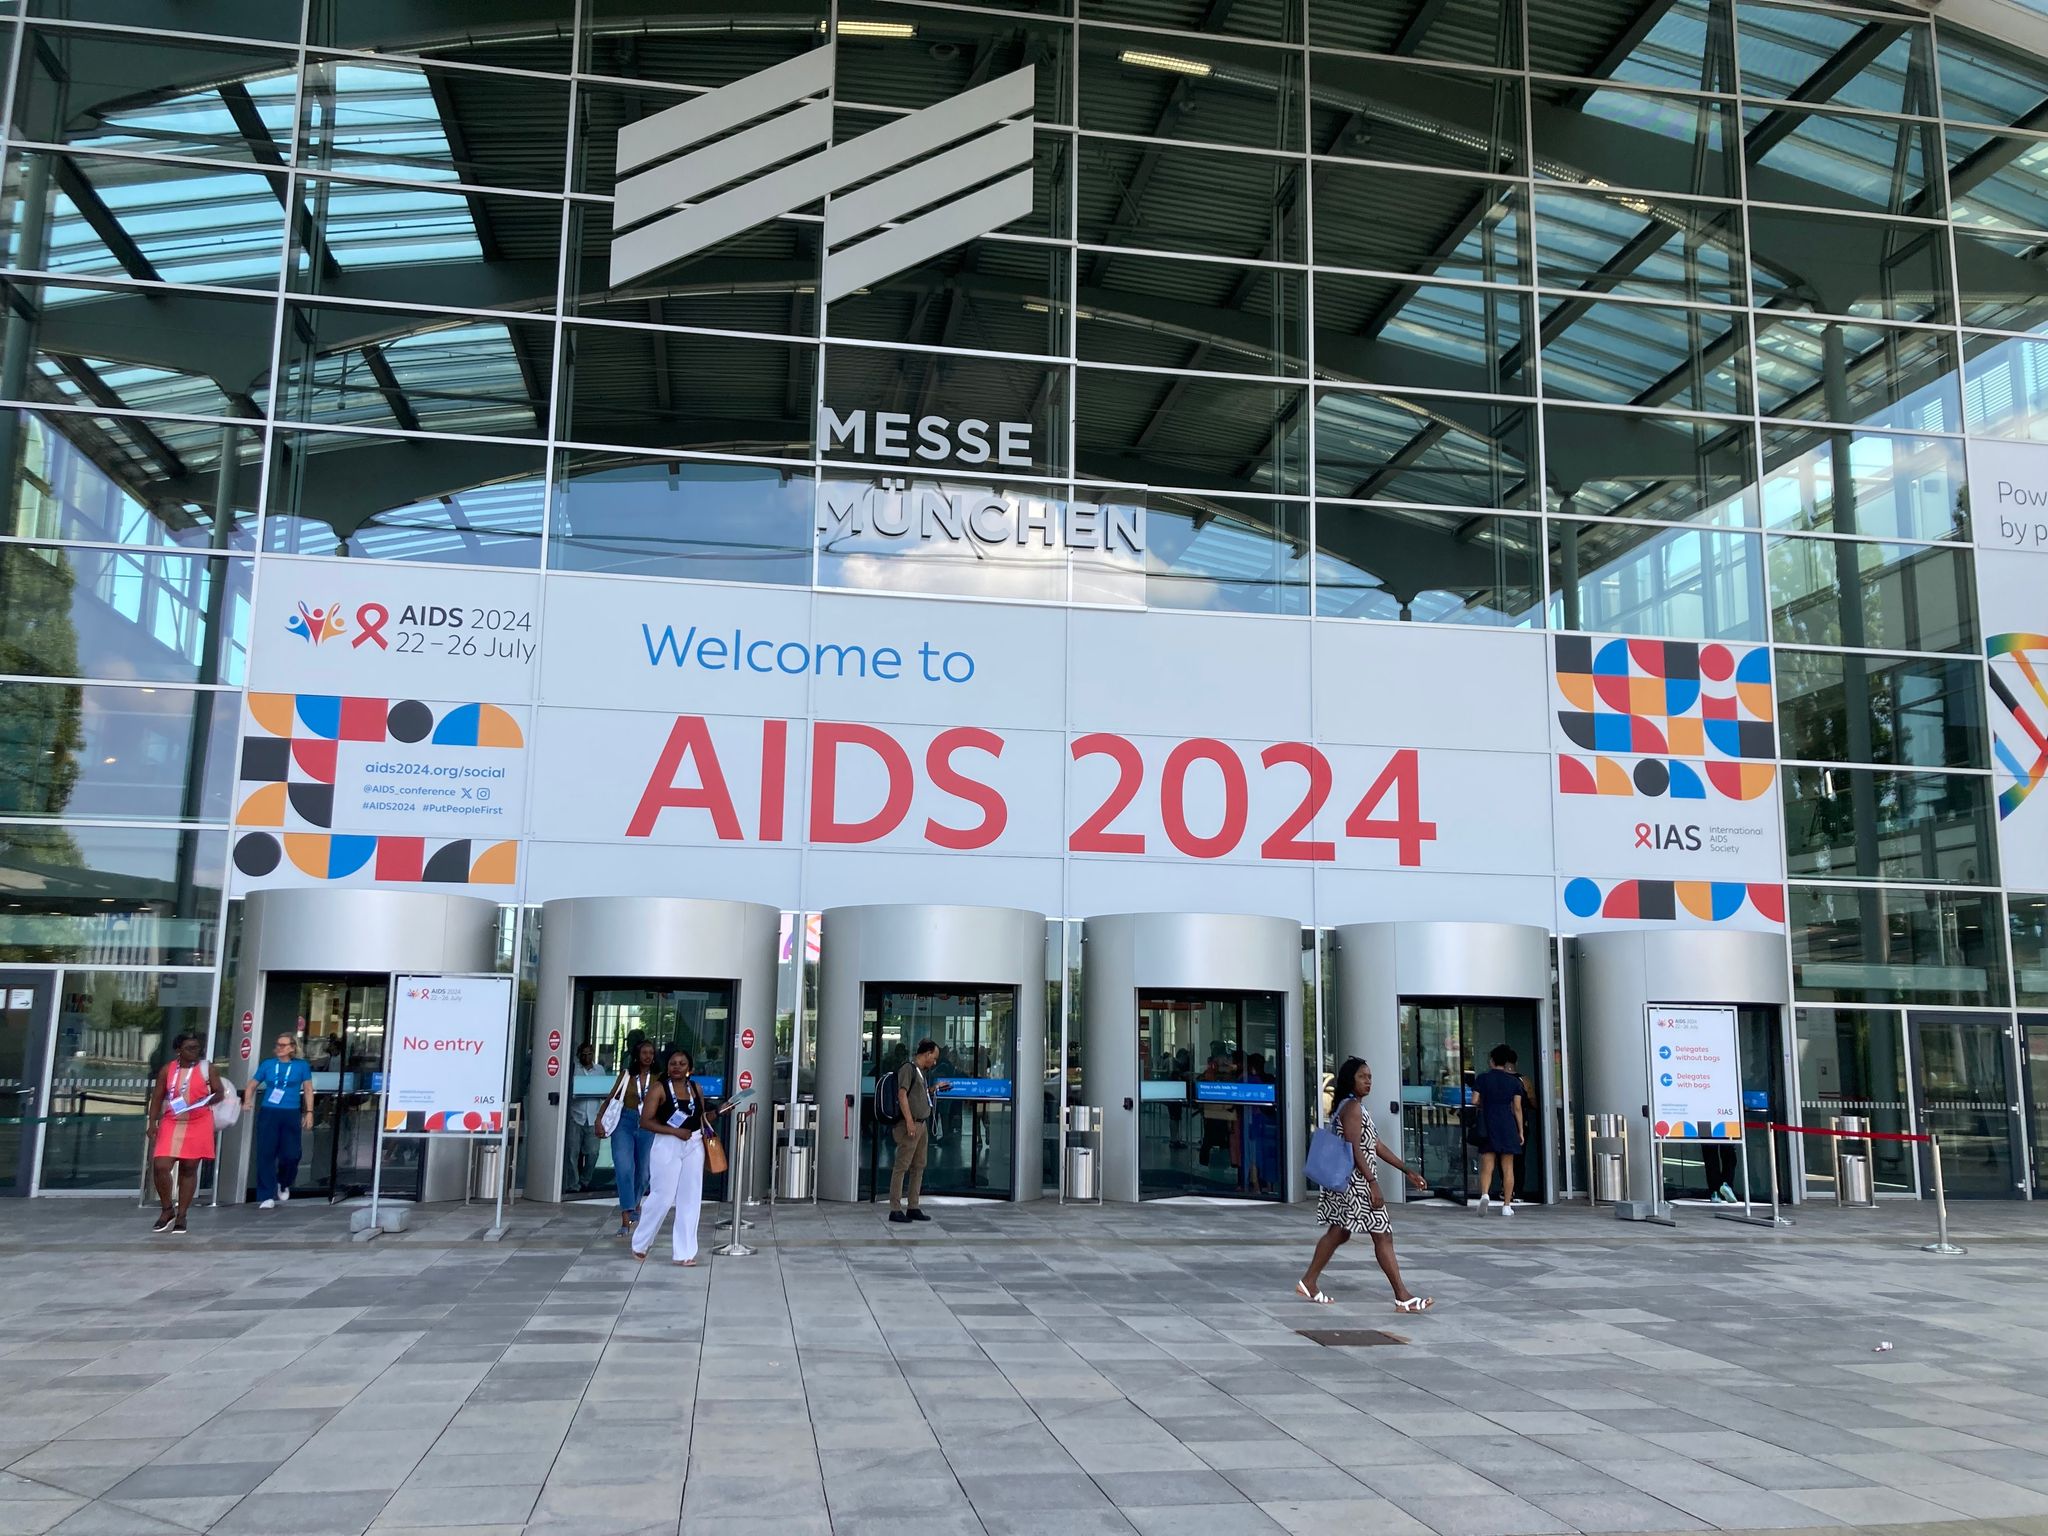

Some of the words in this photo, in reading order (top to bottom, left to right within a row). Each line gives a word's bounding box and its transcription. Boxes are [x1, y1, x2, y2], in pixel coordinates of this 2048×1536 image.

[820, 407, 1033, 467] MESSE
[1998, 481, 2047, 506] Pow
[818, 478, 1147, 552] MÜNCHEN
[2000, 514, 2027, 546] by
[399, 605, 464, 628] AIDS
[471, 608, 532, 632] 2024
[483, 636, 537, 665] July
[641, 623, 902, 680] Welcome
[918, 641, 975, 683] to
[365, 761, 505, 779] aids2024.org/social
[363, 784, 456, 796] @AIDS_conference
[624, 715, 1009, 850] AIDS
[1069, 732, 1437, 867] 2024
[362, 802, 416, 812] #AIDS2024
[422, 804, 503, 815] #PutPeopleFirst
[1655, 824, 1702, 851] IAS
[1709, 826, 1763, 836] International
[1710, 835, 1728, 843] AIDS
[1710, 844, 1740, 854] Society
[403, 1036, 429, 1051] No
[434, 1037, 484, 1055] entry
[1675, 1045, 1709, 1054] Delegates
[1677, 1073, 1711, 1081] Delegates
[1694, 1082, 1711, 1090] bags
[480, 1096, 495, 1104] IAS
